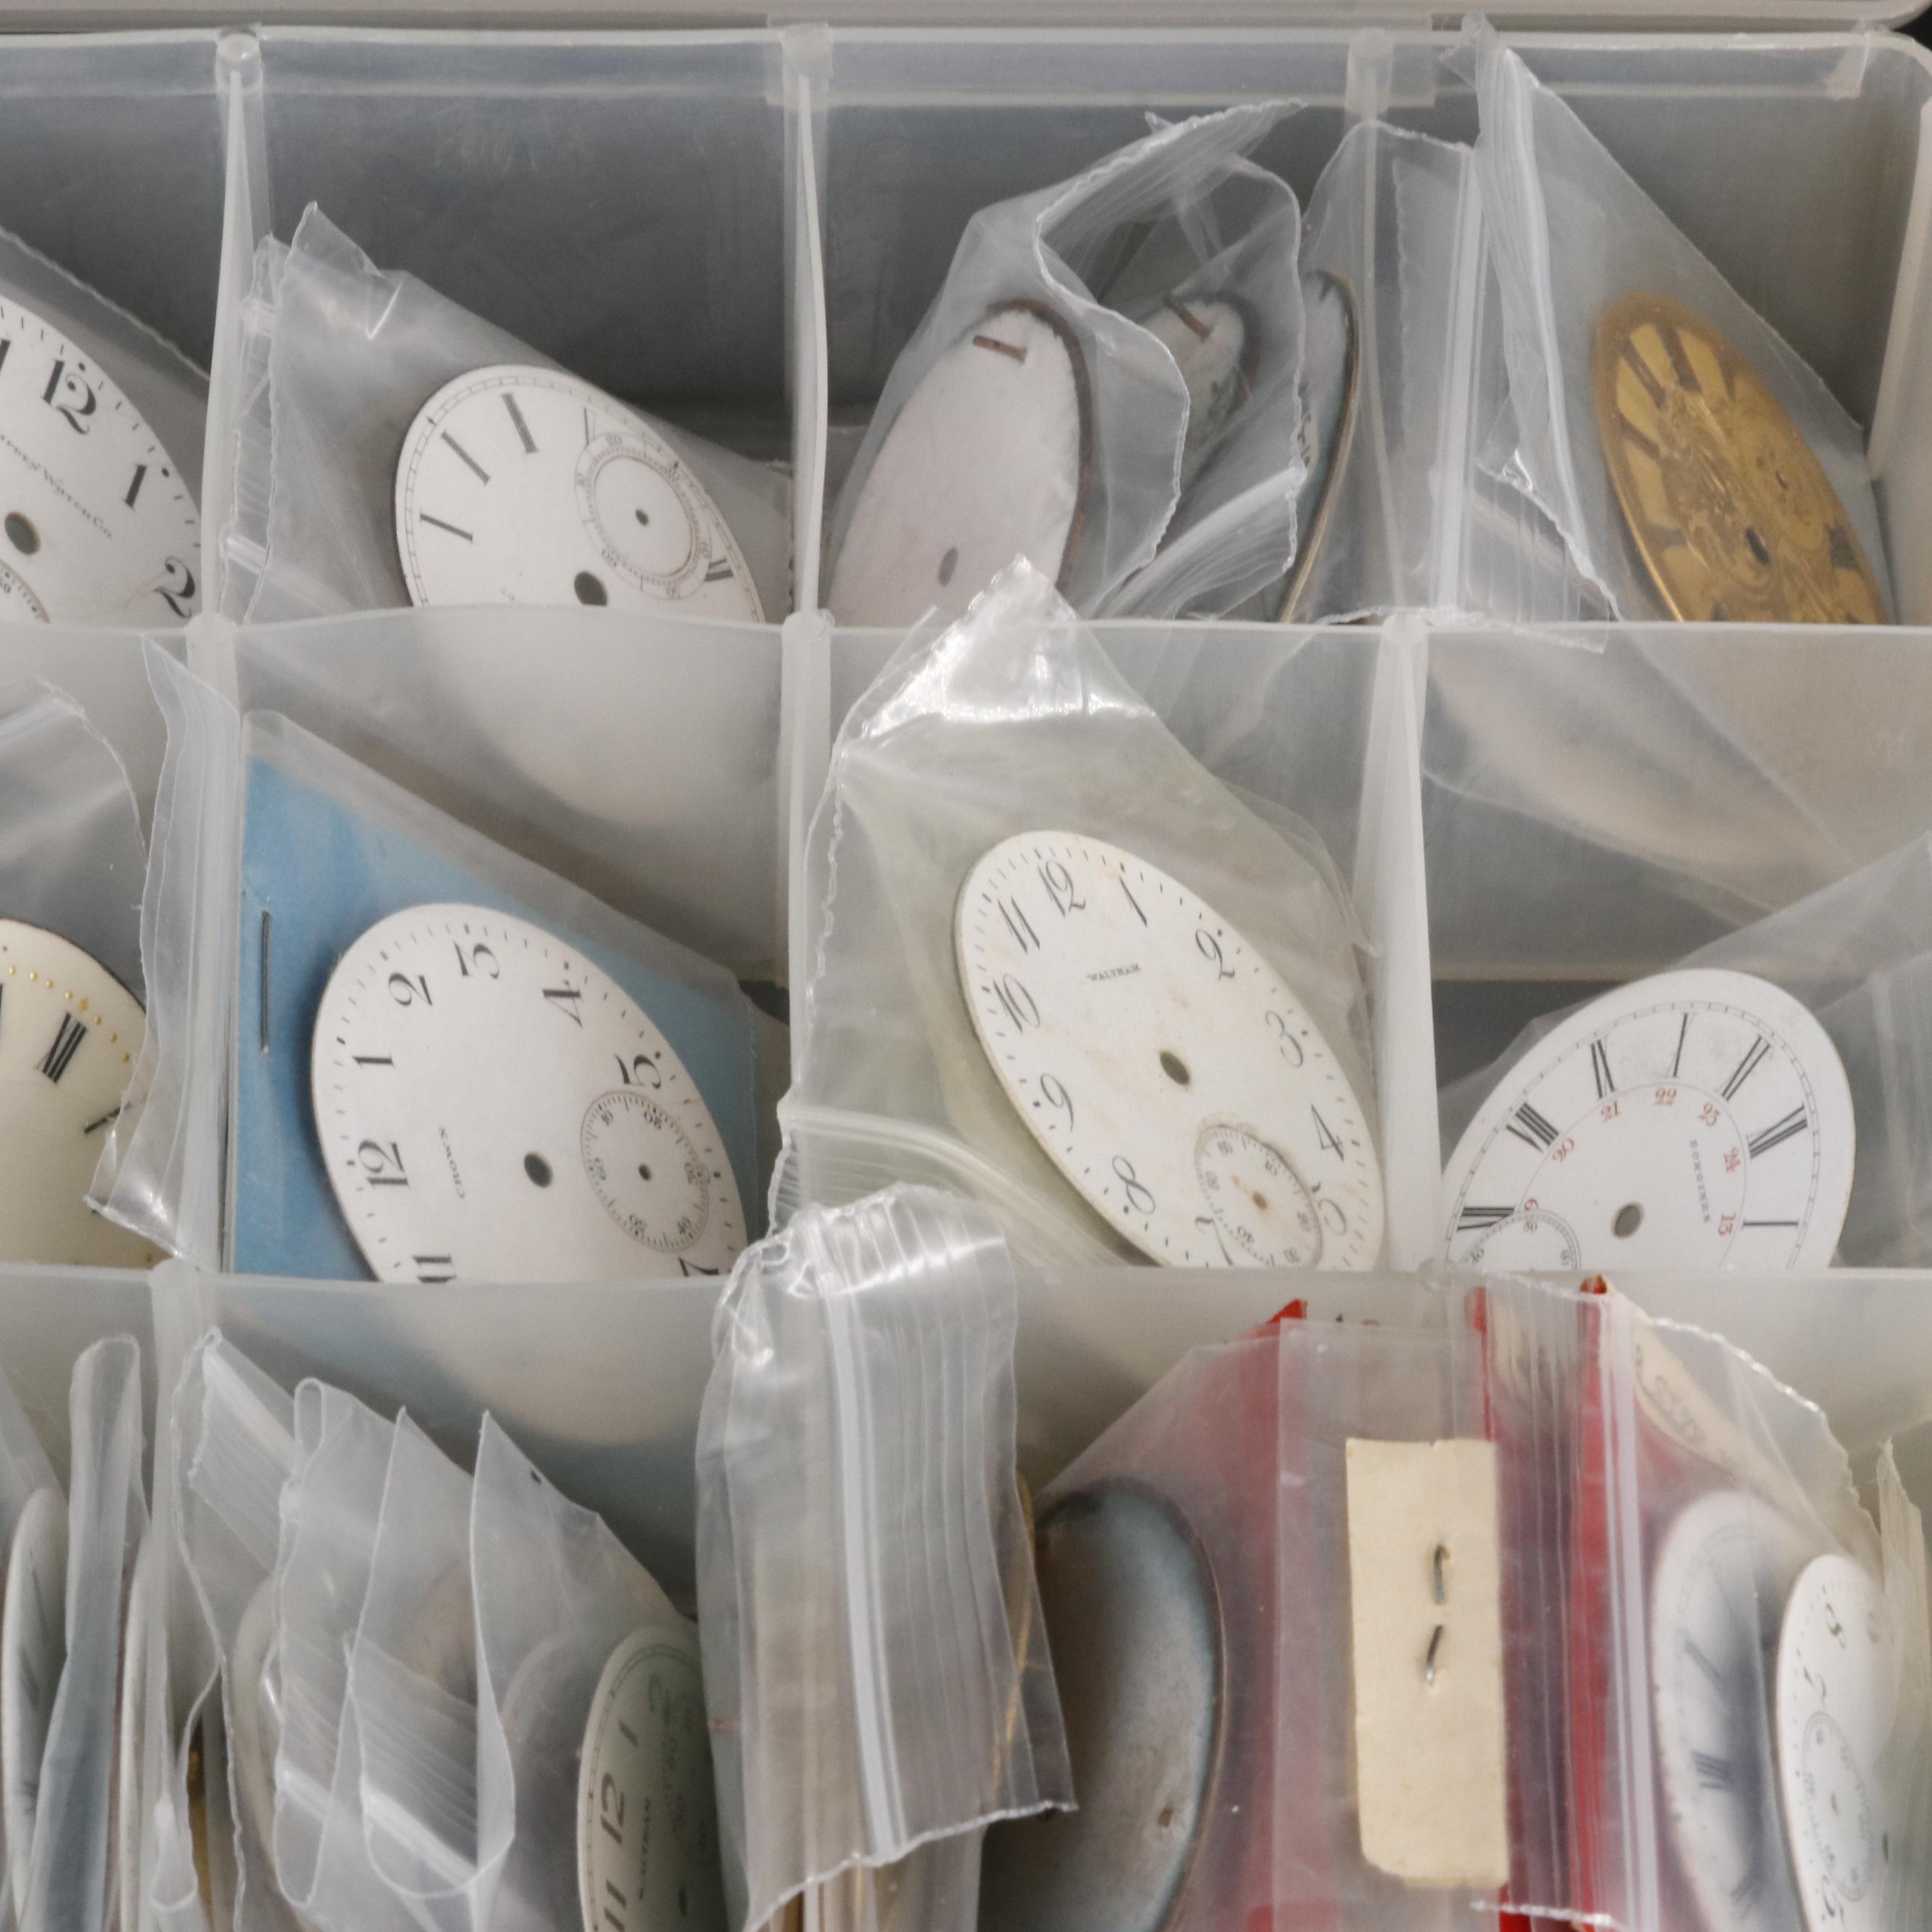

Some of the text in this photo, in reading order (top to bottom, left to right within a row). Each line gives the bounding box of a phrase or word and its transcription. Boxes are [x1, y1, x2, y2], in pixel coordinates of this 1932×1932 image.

[43, 360, 97, 435] 12
[121, 463, 147, 510] 1
[153, 556, 196, 618] 2
[1038, 860, 1086, 918] 12
[1119, 874, 1148, 927] 1
[997, 895, 1041, 954] 11
[454, 942, 500, 980] 3
[1086, 963, 1141, 982] WALTHAM
[1194, 928, 1235, 981] 2
[387, 973, 433, 1007] 2
[541, 981, 583, 1027] 4
[992, 973, 1042, 1034] 10
[351, 1053, 396, 1069] 1
[1265, 1010, 1304, 1069] 3
[614, 1053, 663, 1089] 5
[1040, 1073, 1074, 1133] 9
[1600, 1098, 1621, 1122] 21
[1654, 1088, 1677, 1107] 22
[1310, 1103, 1345, 1162] 4
[1552, 1137, 1576, 1162] 20
[357, 1139, 410, 1190] 12
[1111, 1155, 1157, 1216] 8
[1688, 1138, 1711, 1224] LONGINES
[1311, 1181, 1348, 1236] 5
[1718, 1210, 1737, 1237] 13
[678, 1256, 721, 1277] 7
[1194, 1216, 1234, 1267] 7
[411, 1253, 457, 1285] 11
[618, 1718, 639, 1747] 1
[599, 1771, 626, 1846] 12
[603, 1878, 628, 1932] 11
